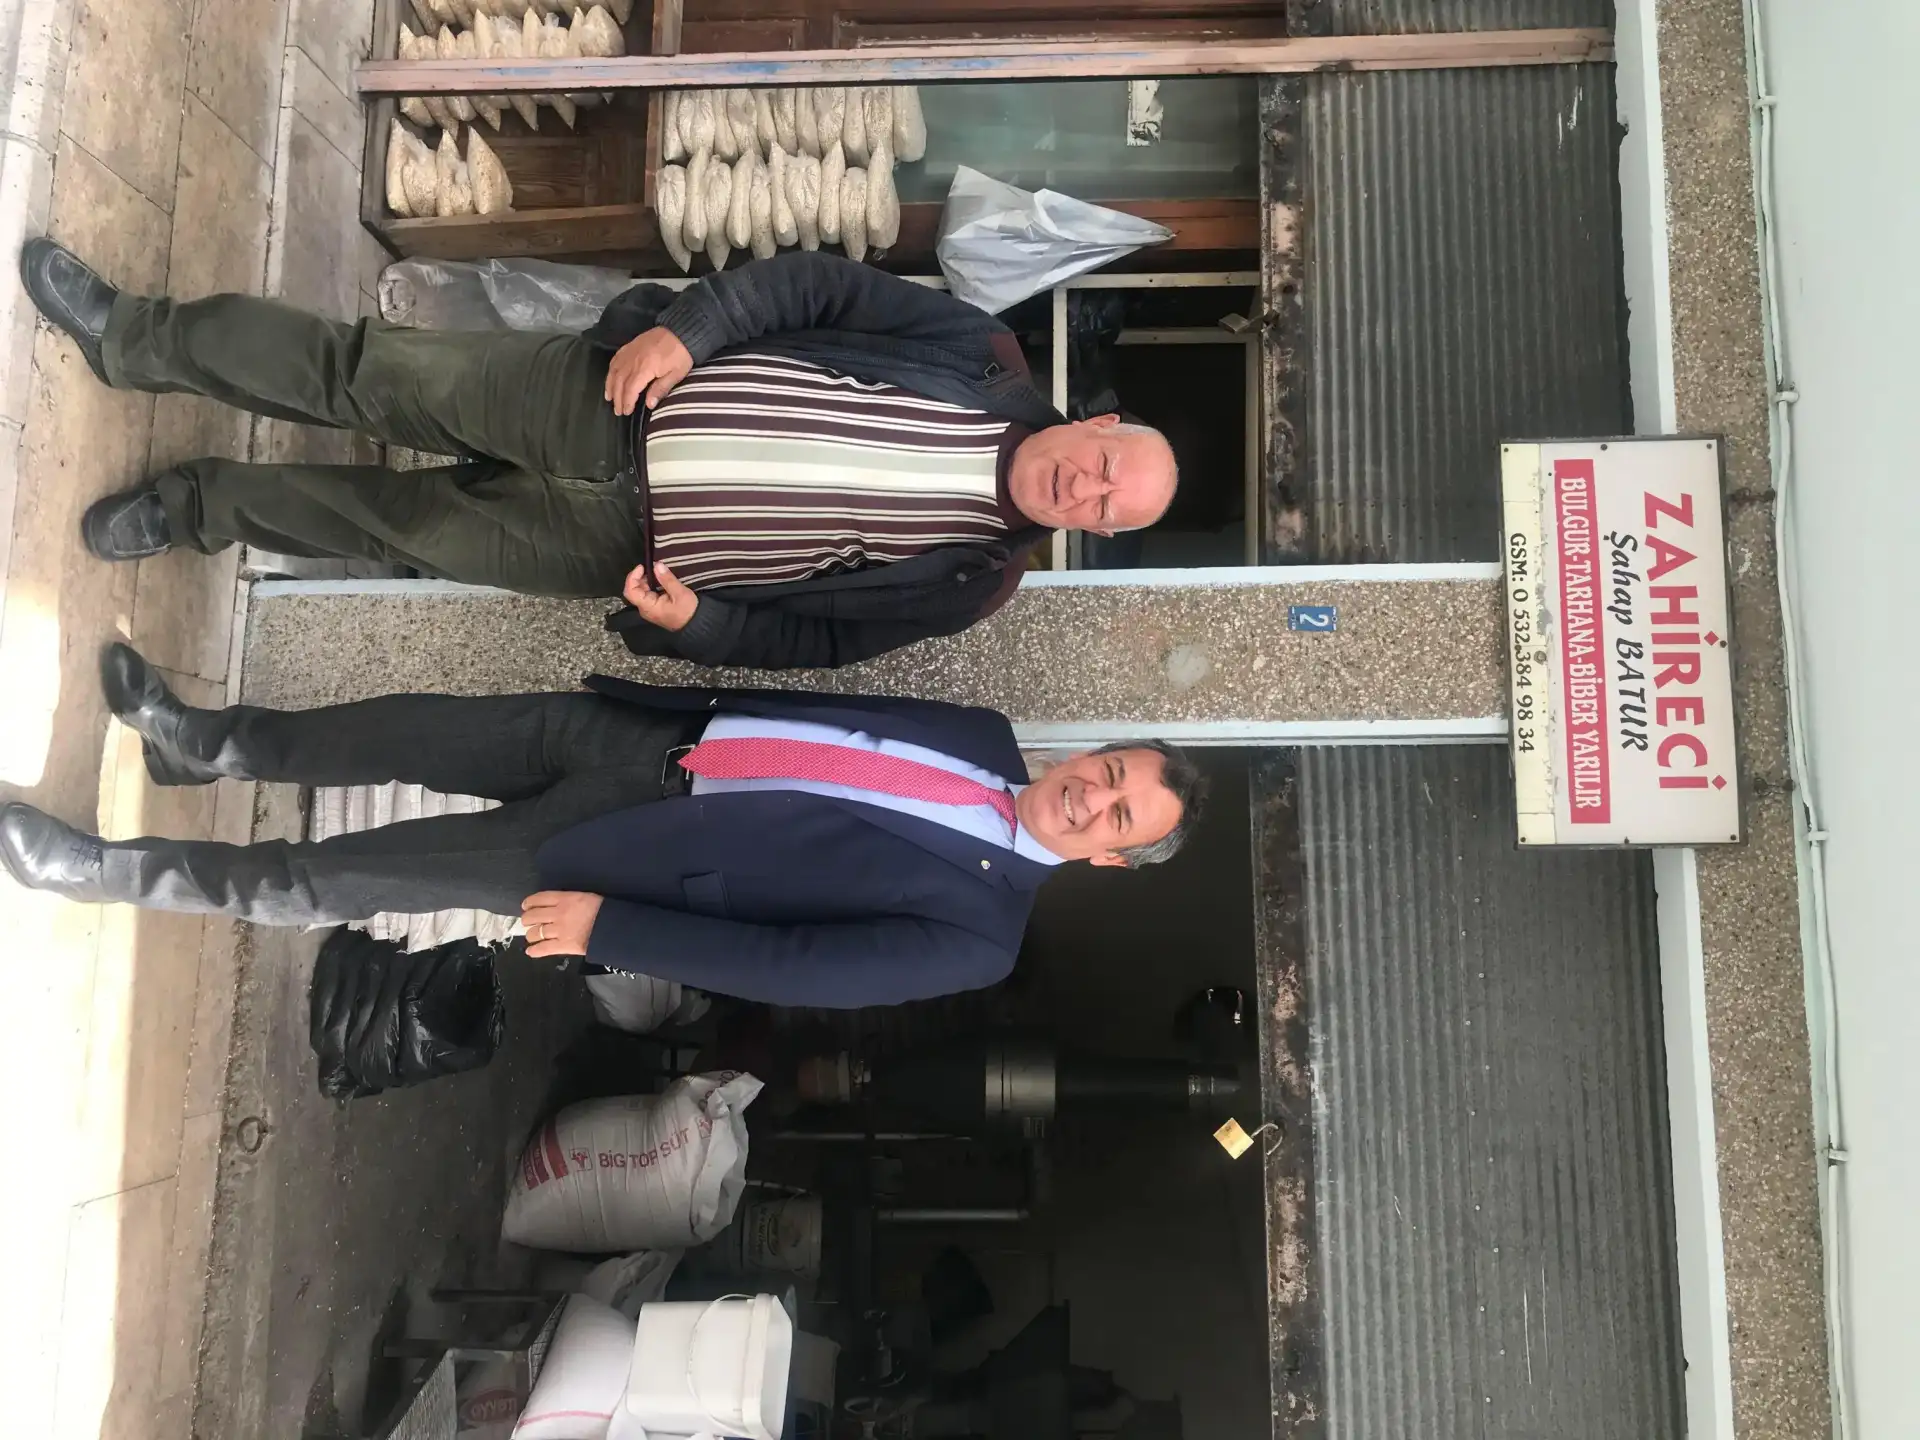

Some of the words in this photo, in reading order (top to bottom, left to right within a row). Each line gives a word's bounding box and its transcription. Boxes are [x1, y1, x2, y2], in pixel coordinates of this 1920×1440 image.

[1510, 532, 1528, 583] GSM:
[1603, 530, 1641, 625] Şahap
[1299, 613, 1329, 627] 2
[1644, 491, 1728, 791] ZAHİRECİ
[1516, 694, 1534, 721] 98
[1615, 637, 1649, 752] BATUR
[1518, 727, 1535, 753] 34
[1572, 729, 1603, 809] YARILIR
